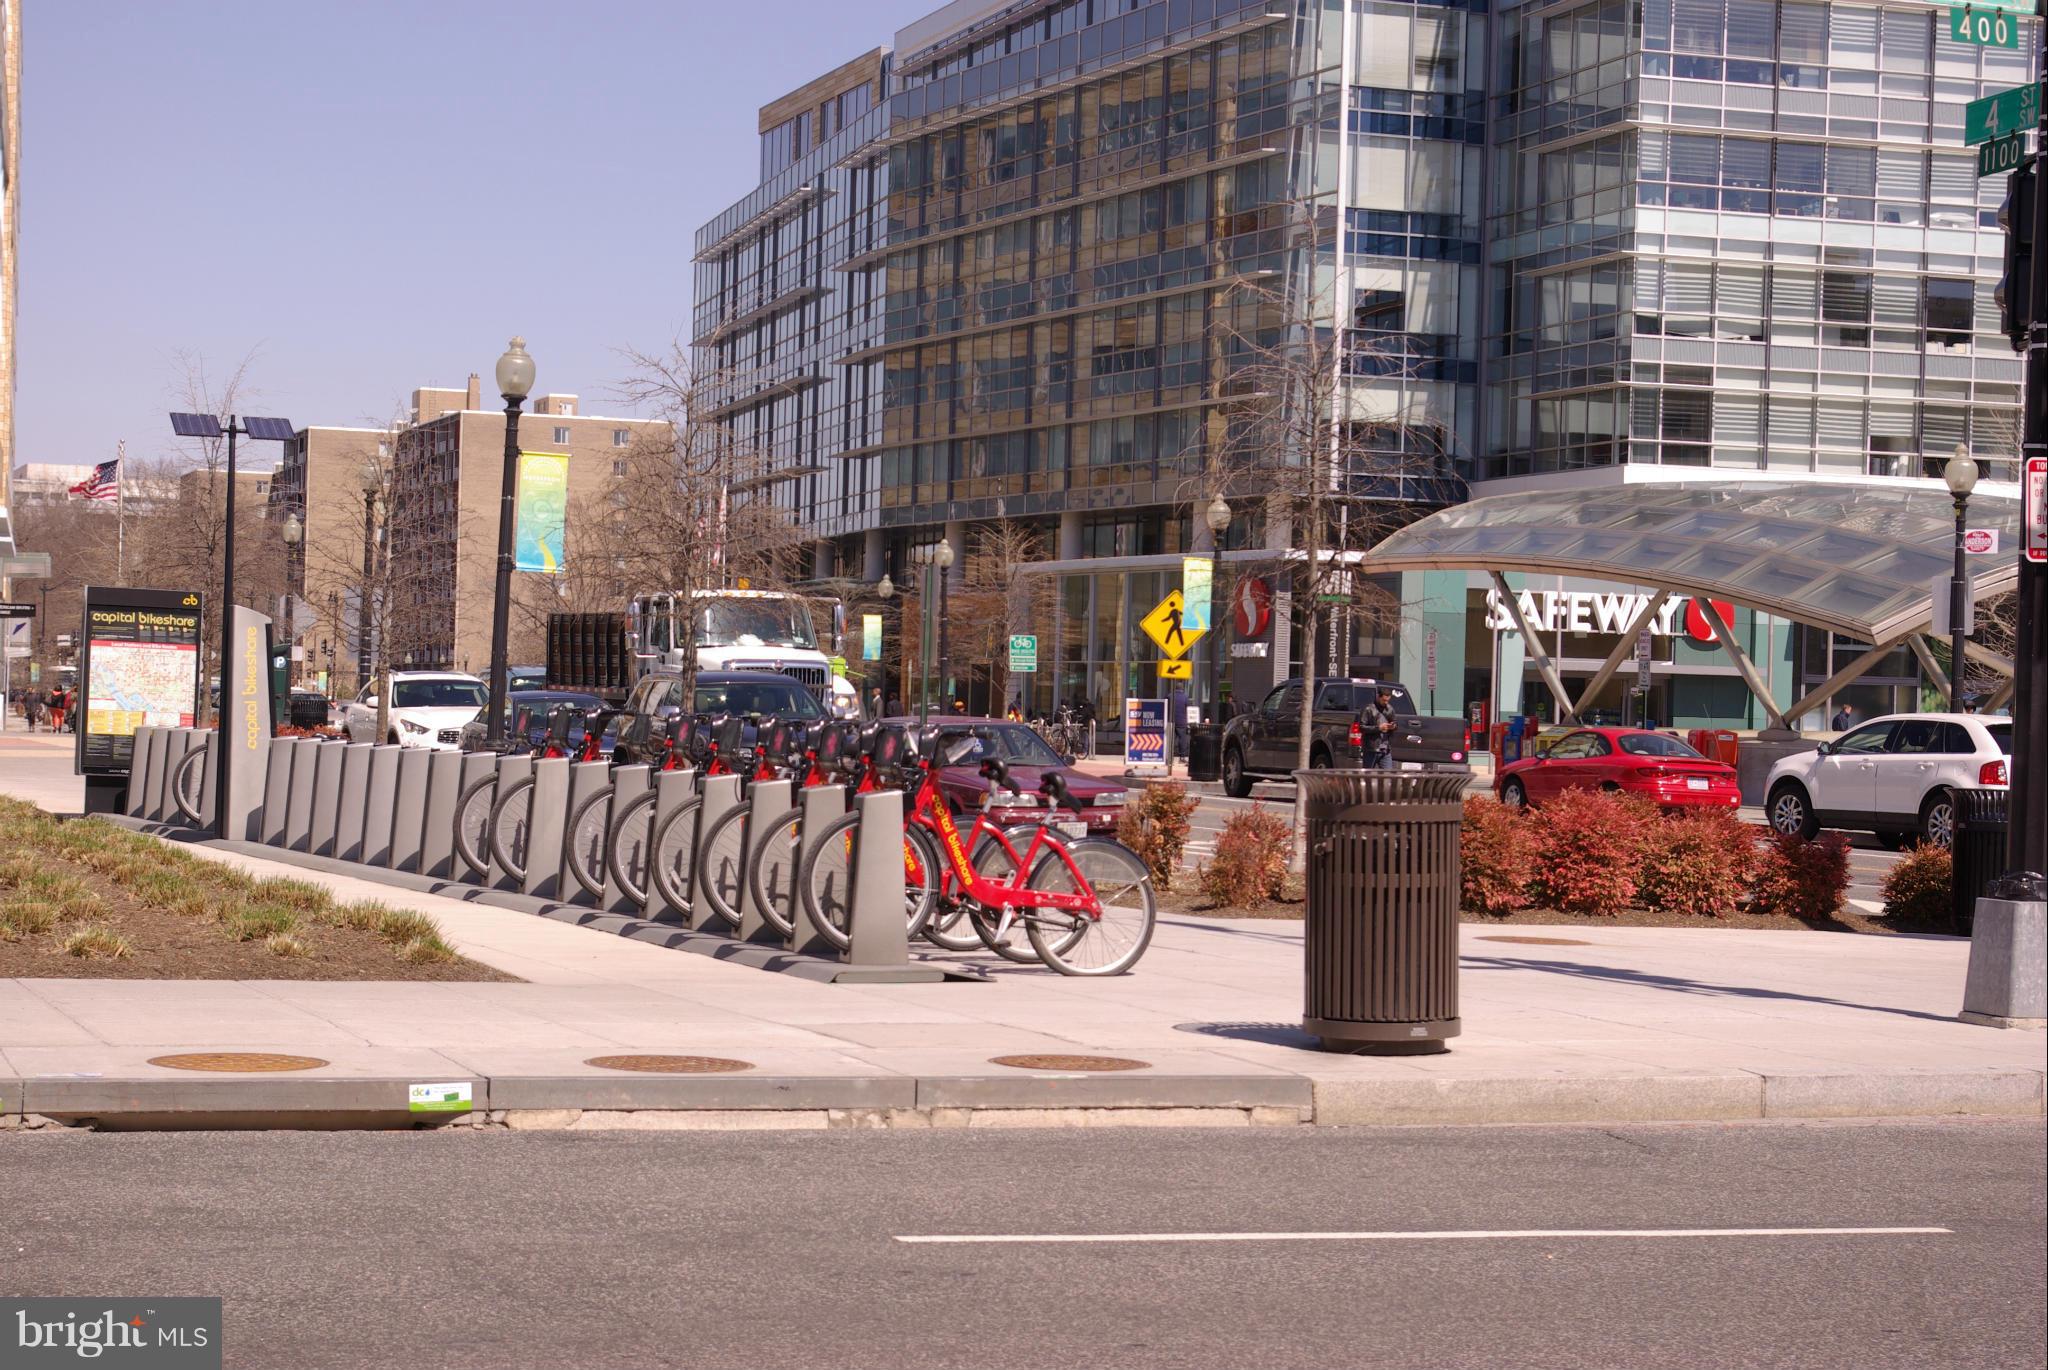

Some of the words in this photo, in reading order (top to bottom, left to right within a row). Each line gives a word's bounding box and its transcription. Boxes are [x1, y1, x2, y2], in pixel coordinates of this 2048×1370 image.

[1959, 15, 2007, 44] 400
[2020, 86, 2037, 108] ST
[1985, 99, 1999, 134] 4
[2019, 107, 2037, 128] SW
[1984, 139, 2019, 172] 1100
[2036, 461, 2047, 470] TO
[2034, 476, 2044, 485] NO
[2035, 488, 2045, 497] OR
[92, 611, 135, 624] capital
[138, 611, 195, 627] bikeshare
[1485, 588, 1684, 636] SAFEWAY
[242, 626, 257, 696] bikeshare
[276, 656, 285, 669] P
[243, 700, 260, 750] capital
[1142, 719, 1164, 727] LEASING
[932, 794, 955, 837] capital
[948, 832, 973, 886] bikeshare
